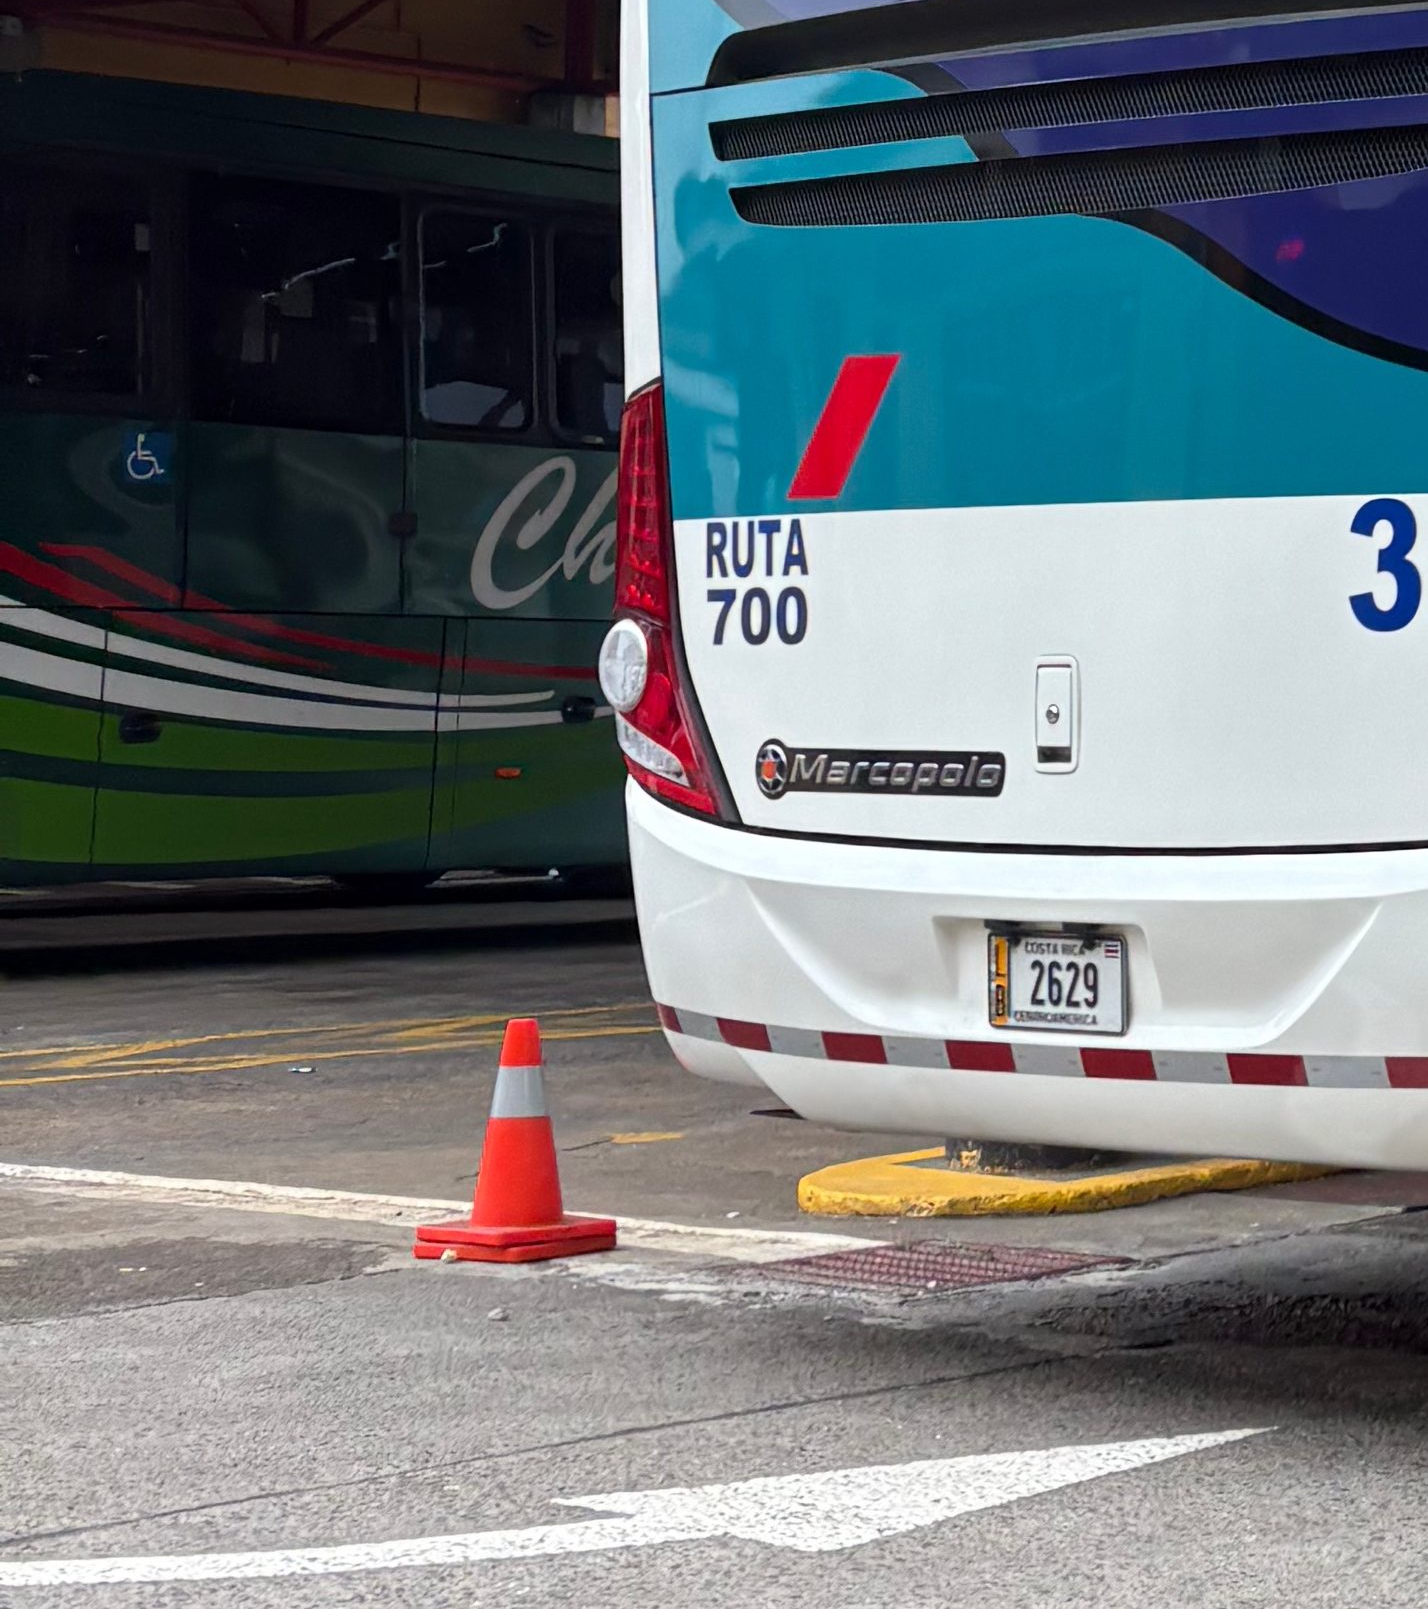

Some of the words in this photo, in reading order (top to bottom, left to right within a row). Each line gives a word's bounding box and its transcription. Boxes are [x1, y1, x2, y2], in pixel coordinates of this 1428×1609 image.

[705, 518, 809, 580] RUTA
[707, 586, 809, 647] 700
[789, 753, 1002, 794] Marcopolo
[1024, 941, 1059, 955] COSTA
[1030, 959, 1098, 1008] 2629
